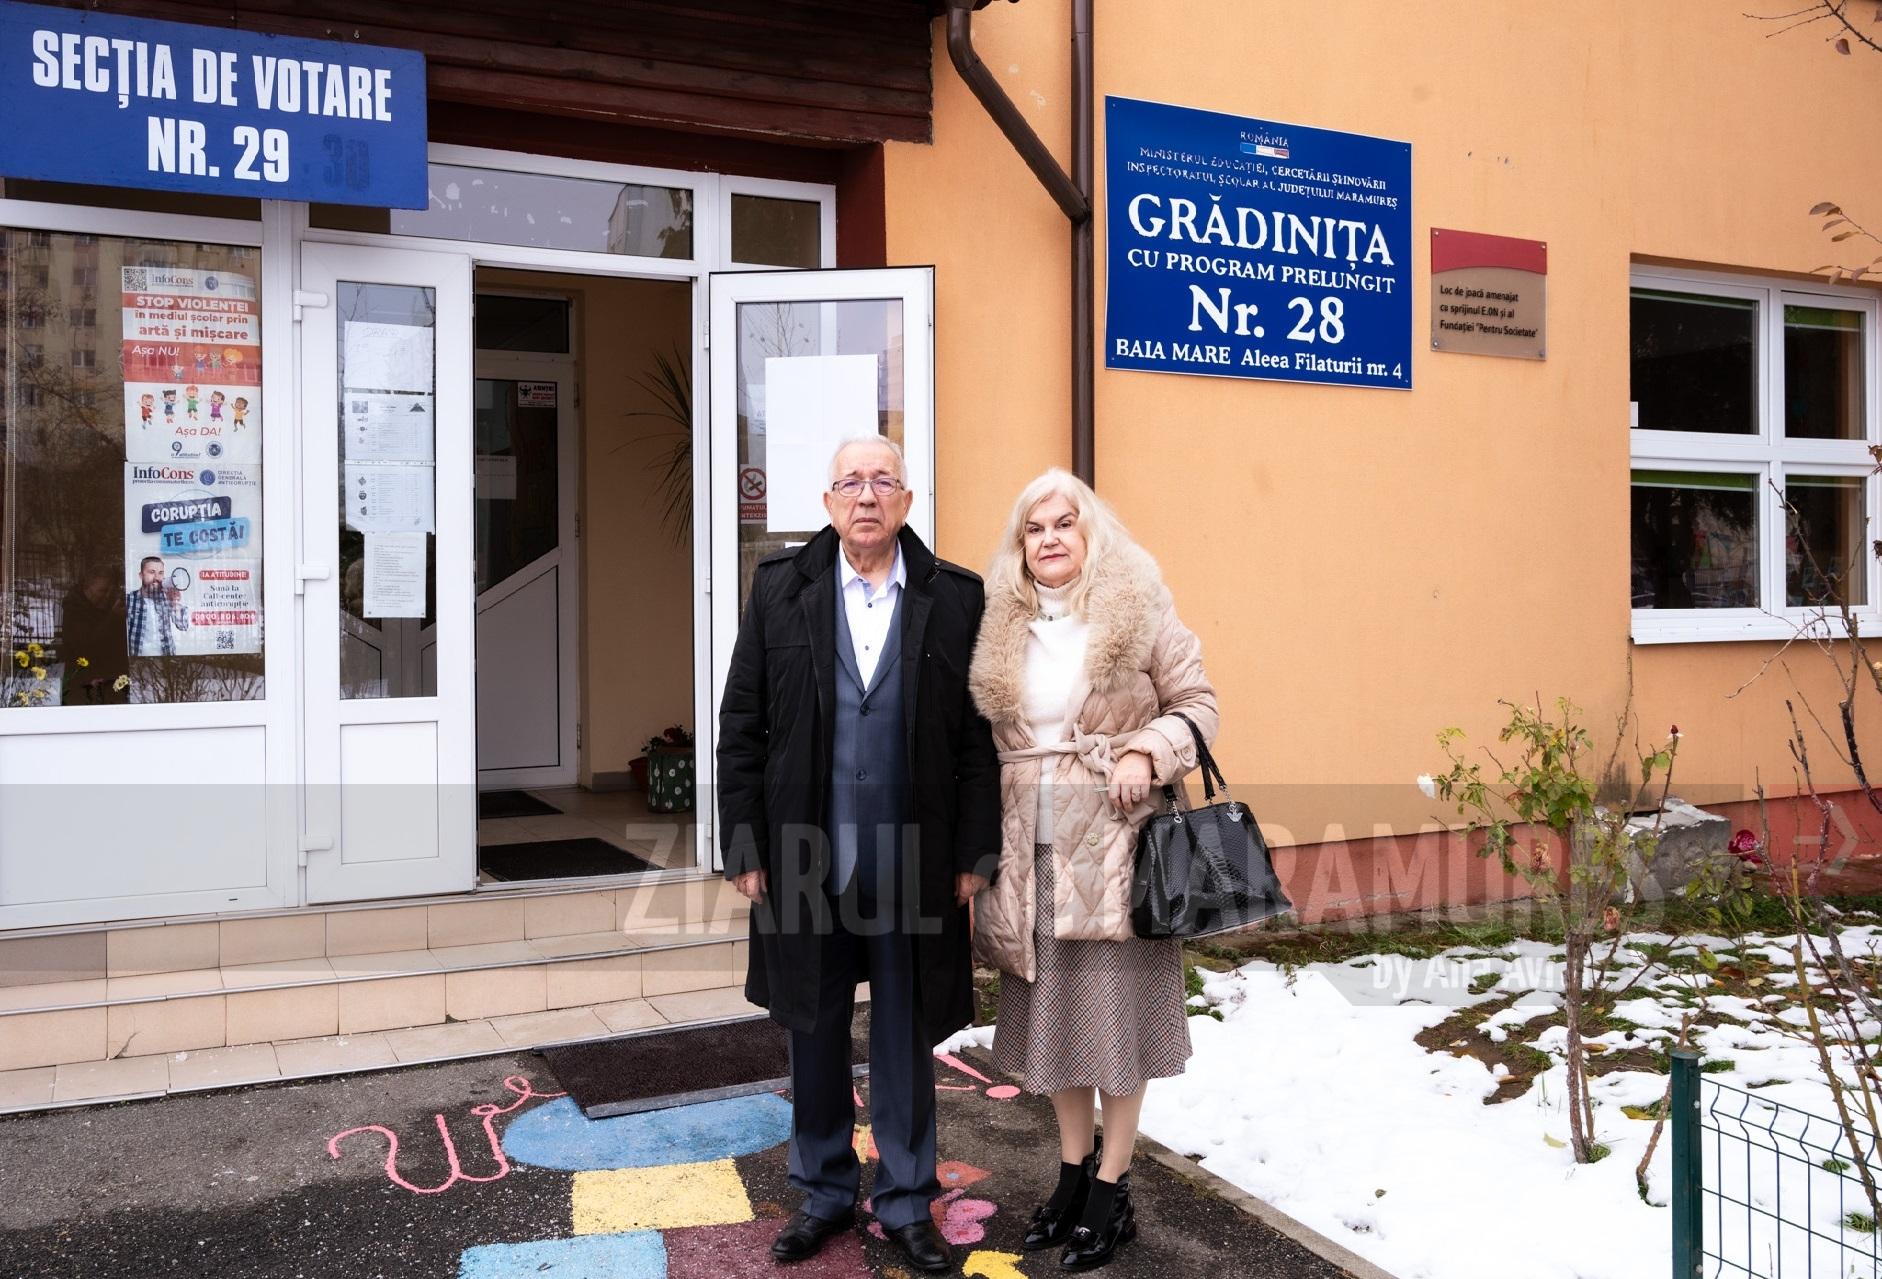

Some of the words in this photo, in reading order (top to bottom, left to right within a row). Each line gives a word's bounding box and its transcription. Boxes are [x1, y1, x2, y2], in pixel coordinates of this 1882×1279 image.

[32, 29, 177, 109] SECȚIA
[192, 48, 238, 106] DE
[252, 55, 392, 122] VOTARE
[1240, 130, 1289, 147] ROMÂNIA
[147, 116, 220, 178] NR.
[233, 125, 290, 183] 29
[1139, 147, 1208, 166] MINISTERUL
[1271, 164, 1330, 183] CERCETĂRII
[1126, 161, 1216, 185] INSPECTORATUL
[1218, 174, 1260, 189] ȘCOLAR
[1277, 182, 1334, 199] JUDEȚULUI
[1336, 191, 1399, 211] MARAMUREȘ
[1127, 193, 1396, 270] GRĂDINIȚA
[1127, 248, 1160, 268] CU
[1165, 252, 1276, 281] PROGRAM
[1281, 265, 1397, 294] PRELUNGIT
[136, 295, 175, 308] STOP
[1440, 284, 1453, 296] Loc
[1454, 286, 1464, 296] de
[1486, 291, 1519, 303] amenajat
[149, 311, 188, 321] mediul
[190, 313, 224, 324] școlar
[226, 316, 248, 325] prin
[1187, 284, 1266, 339] Nr.
[1286, 296, 1346, 345] 28
[1450, 304, 1480, 316] sprijinul
[1481, 306, 1499, 317] E.ON
[1500, 309, 1506, 319] și
[1508, 309, 1515, 318] al
[138, 324, 169, 337] artă
[174, 325, 187, 340] și
[190, 326, 249, 342] mișcare
[1440, 319, 1475, 333] Fundației
[157, 347, 180, 356] NU!
[1115, 338, 1167, 360] BAIA
[1172, 342, 1231, 365] MARE
[1240, 349, 1290, 369] Aleea
[1294, 352, 1363, 376] Filaturii
[1366, 362, 1389, 377] nr.
[1392, 363, 1402, 380] 4
[133, 466, 194, 480] InfoCons
[151, 502, 222, 523] CORUPȚIA
[163, 531, 184, 547] TE
[188, 520, 245, 545] COSTĂ!
